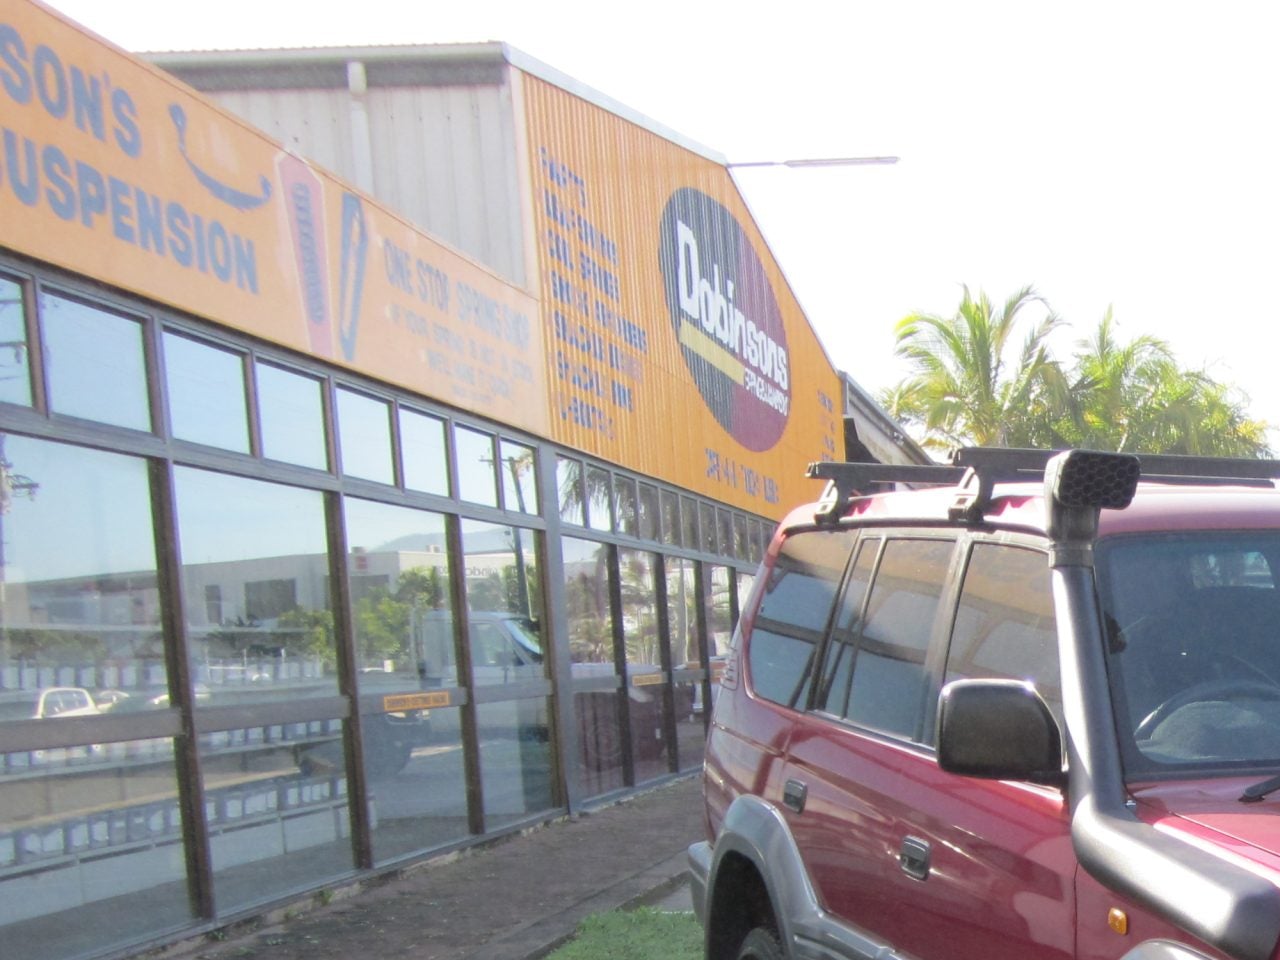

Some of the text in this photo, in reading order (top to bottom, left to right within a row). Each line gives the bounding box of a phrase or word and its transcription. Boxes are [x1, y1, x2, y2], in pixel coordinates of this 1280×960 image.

[0, 23, 142, 158] SON'S
[0, 128, 259, 294] USPENSION
[677, 220, 788, 390] Dobinsons
